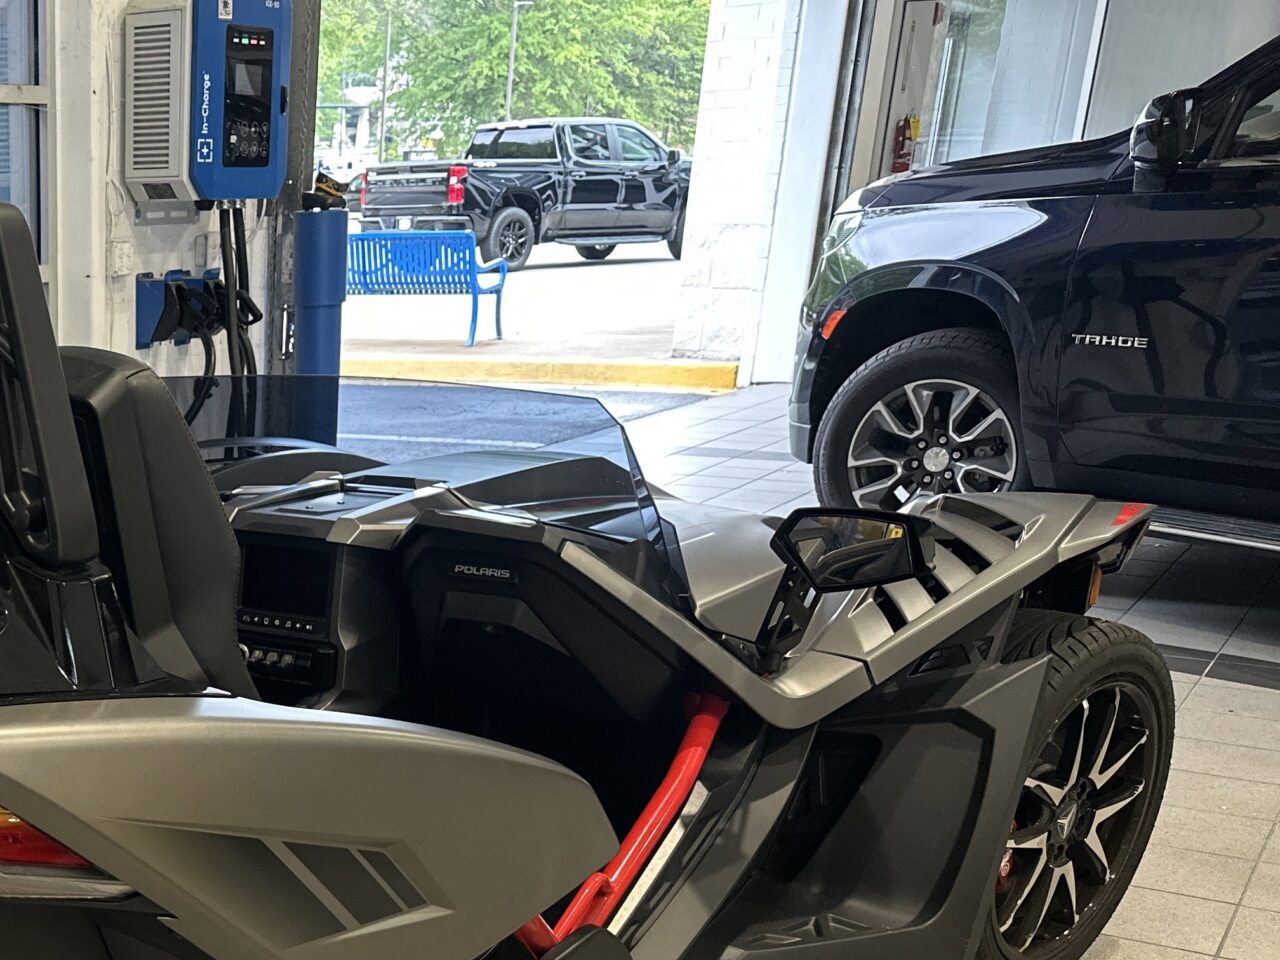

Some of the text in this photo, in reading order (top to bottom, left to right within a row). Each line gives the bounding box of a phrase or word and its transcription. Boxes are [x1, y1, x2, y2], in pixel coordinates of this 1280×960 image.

[200, 73, 211, 134] In-Charge
[1071, 333, 1149, 348] TAHOE
[455, 564, 510, 578] POLARIS
